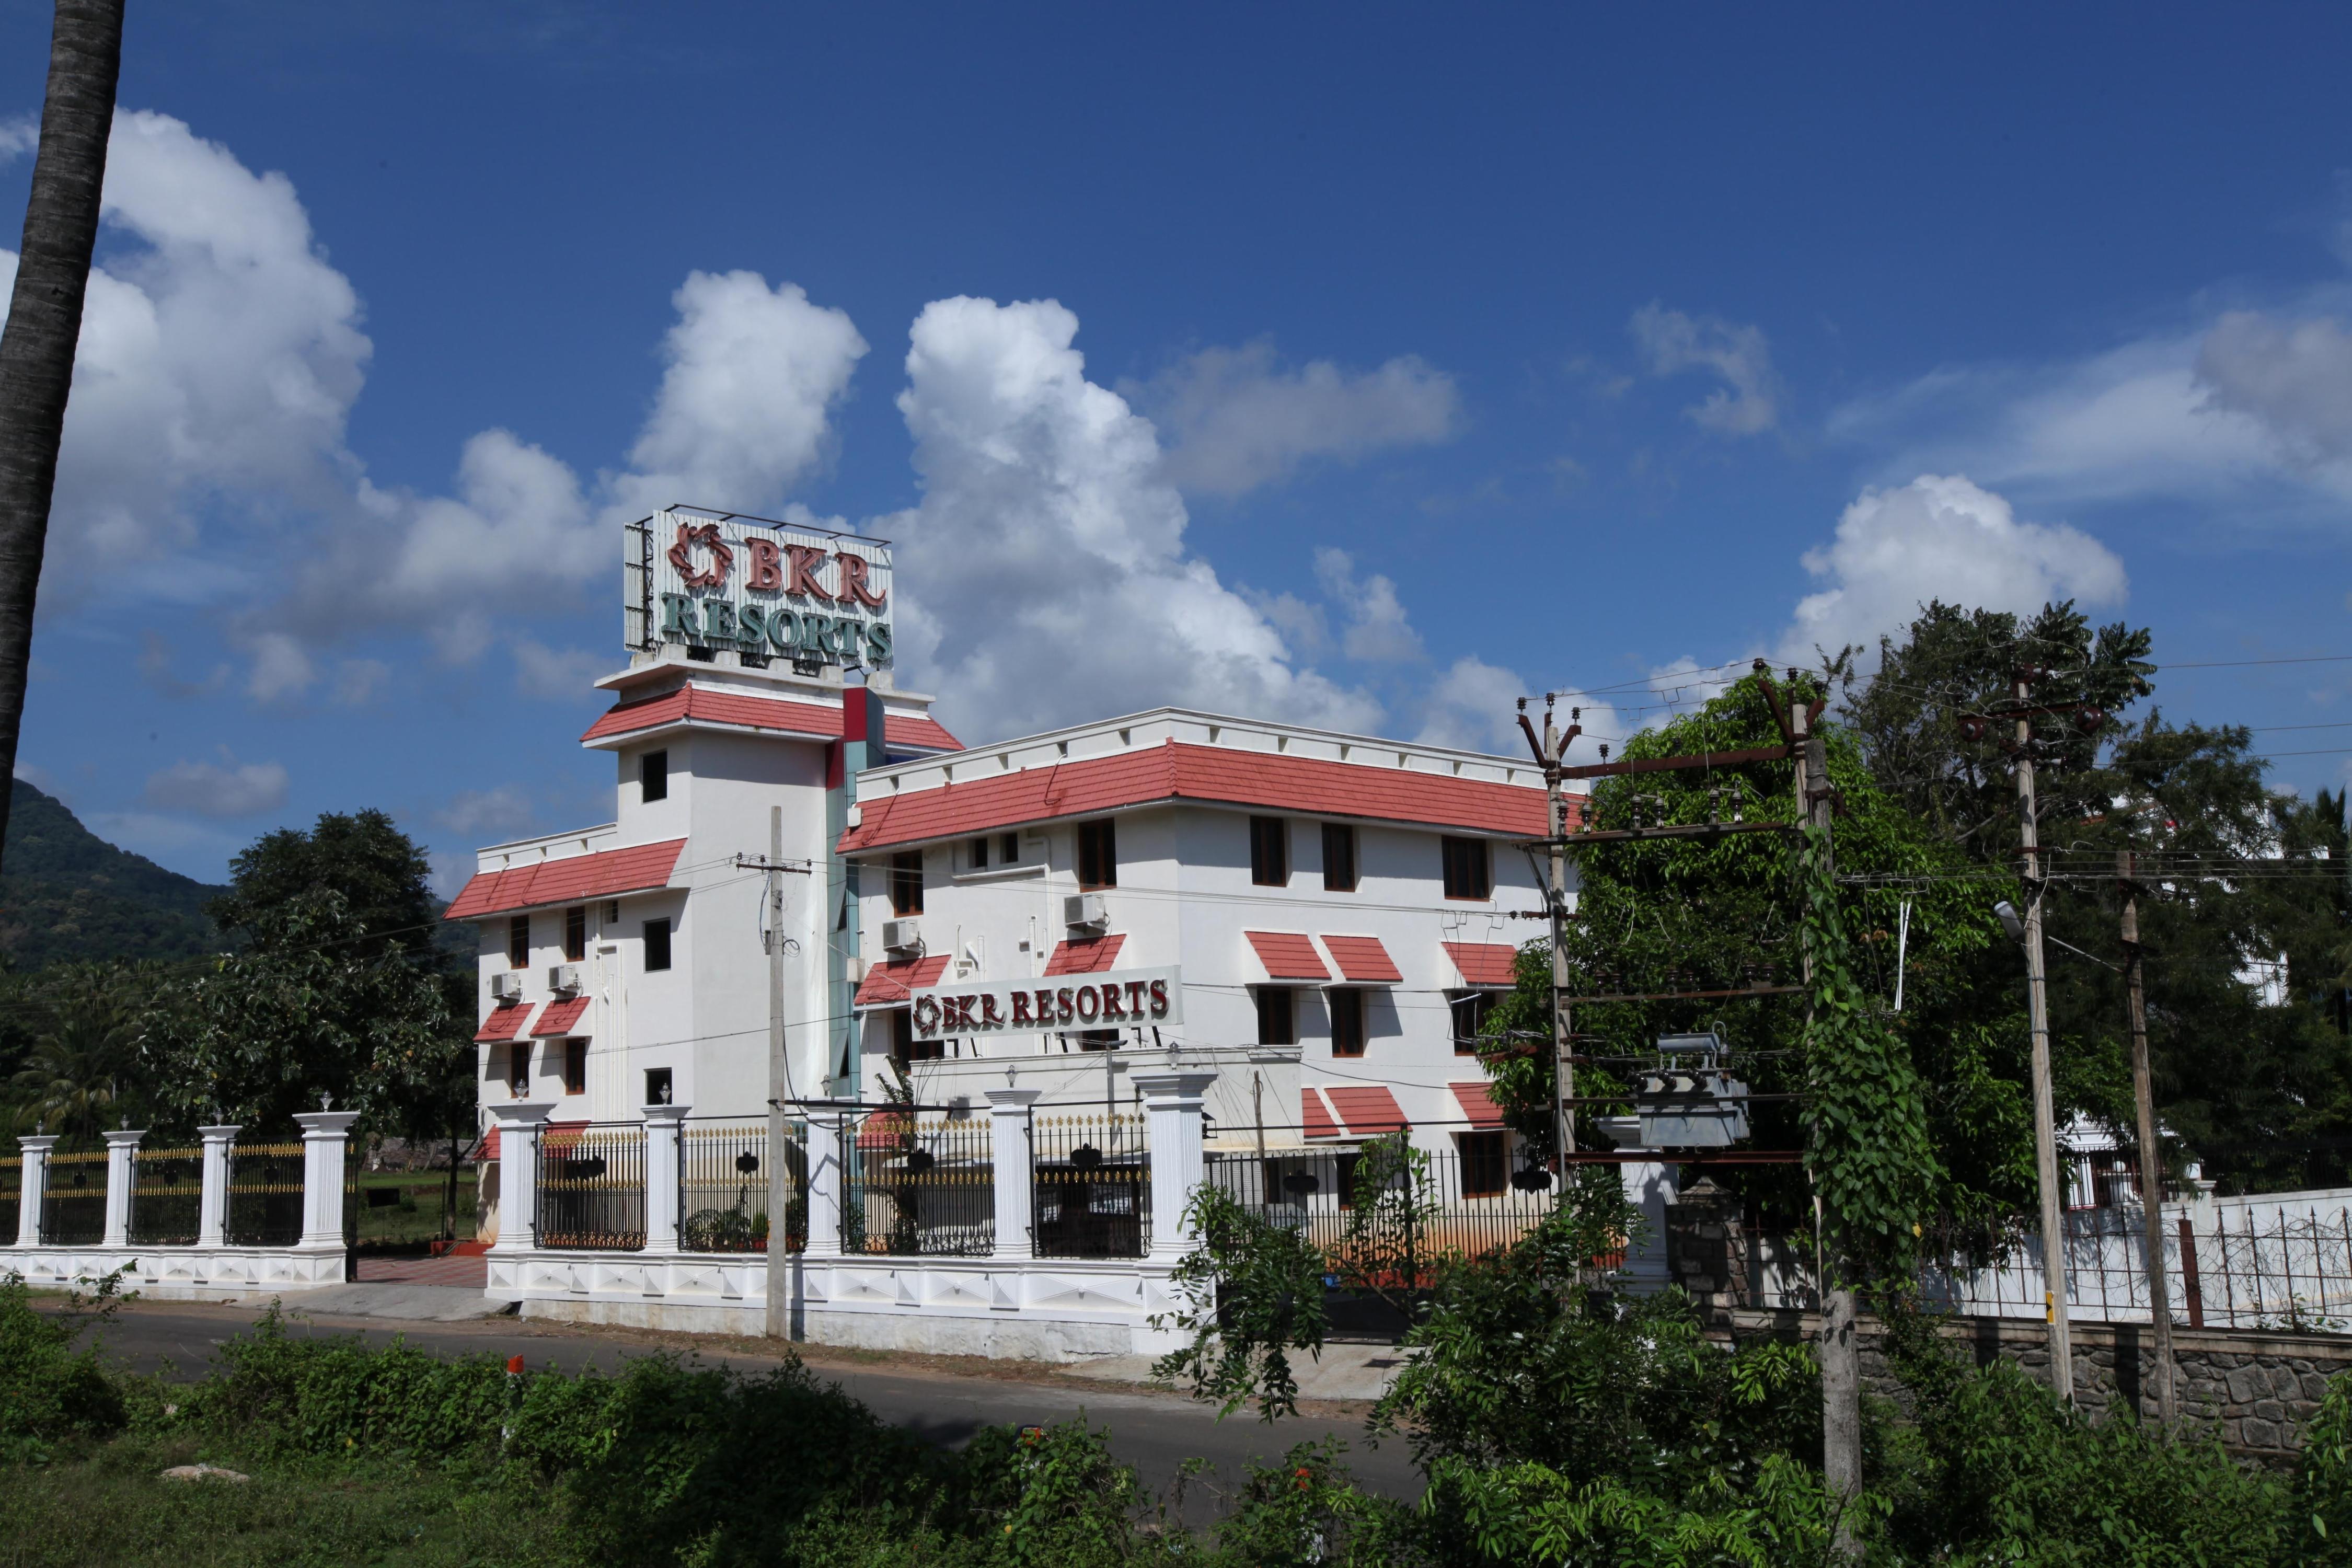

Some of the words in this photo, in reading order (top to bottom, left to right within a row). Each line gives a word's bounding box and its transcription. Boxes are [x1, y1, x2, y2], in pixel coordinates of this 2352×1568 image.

[744, 537, 886, 606] BKR
[661, 592, 893, 661] RESORTS
[941, 993, 1007, 1028] BKR
[1010, 979, 1170, 1023] RESORTS
